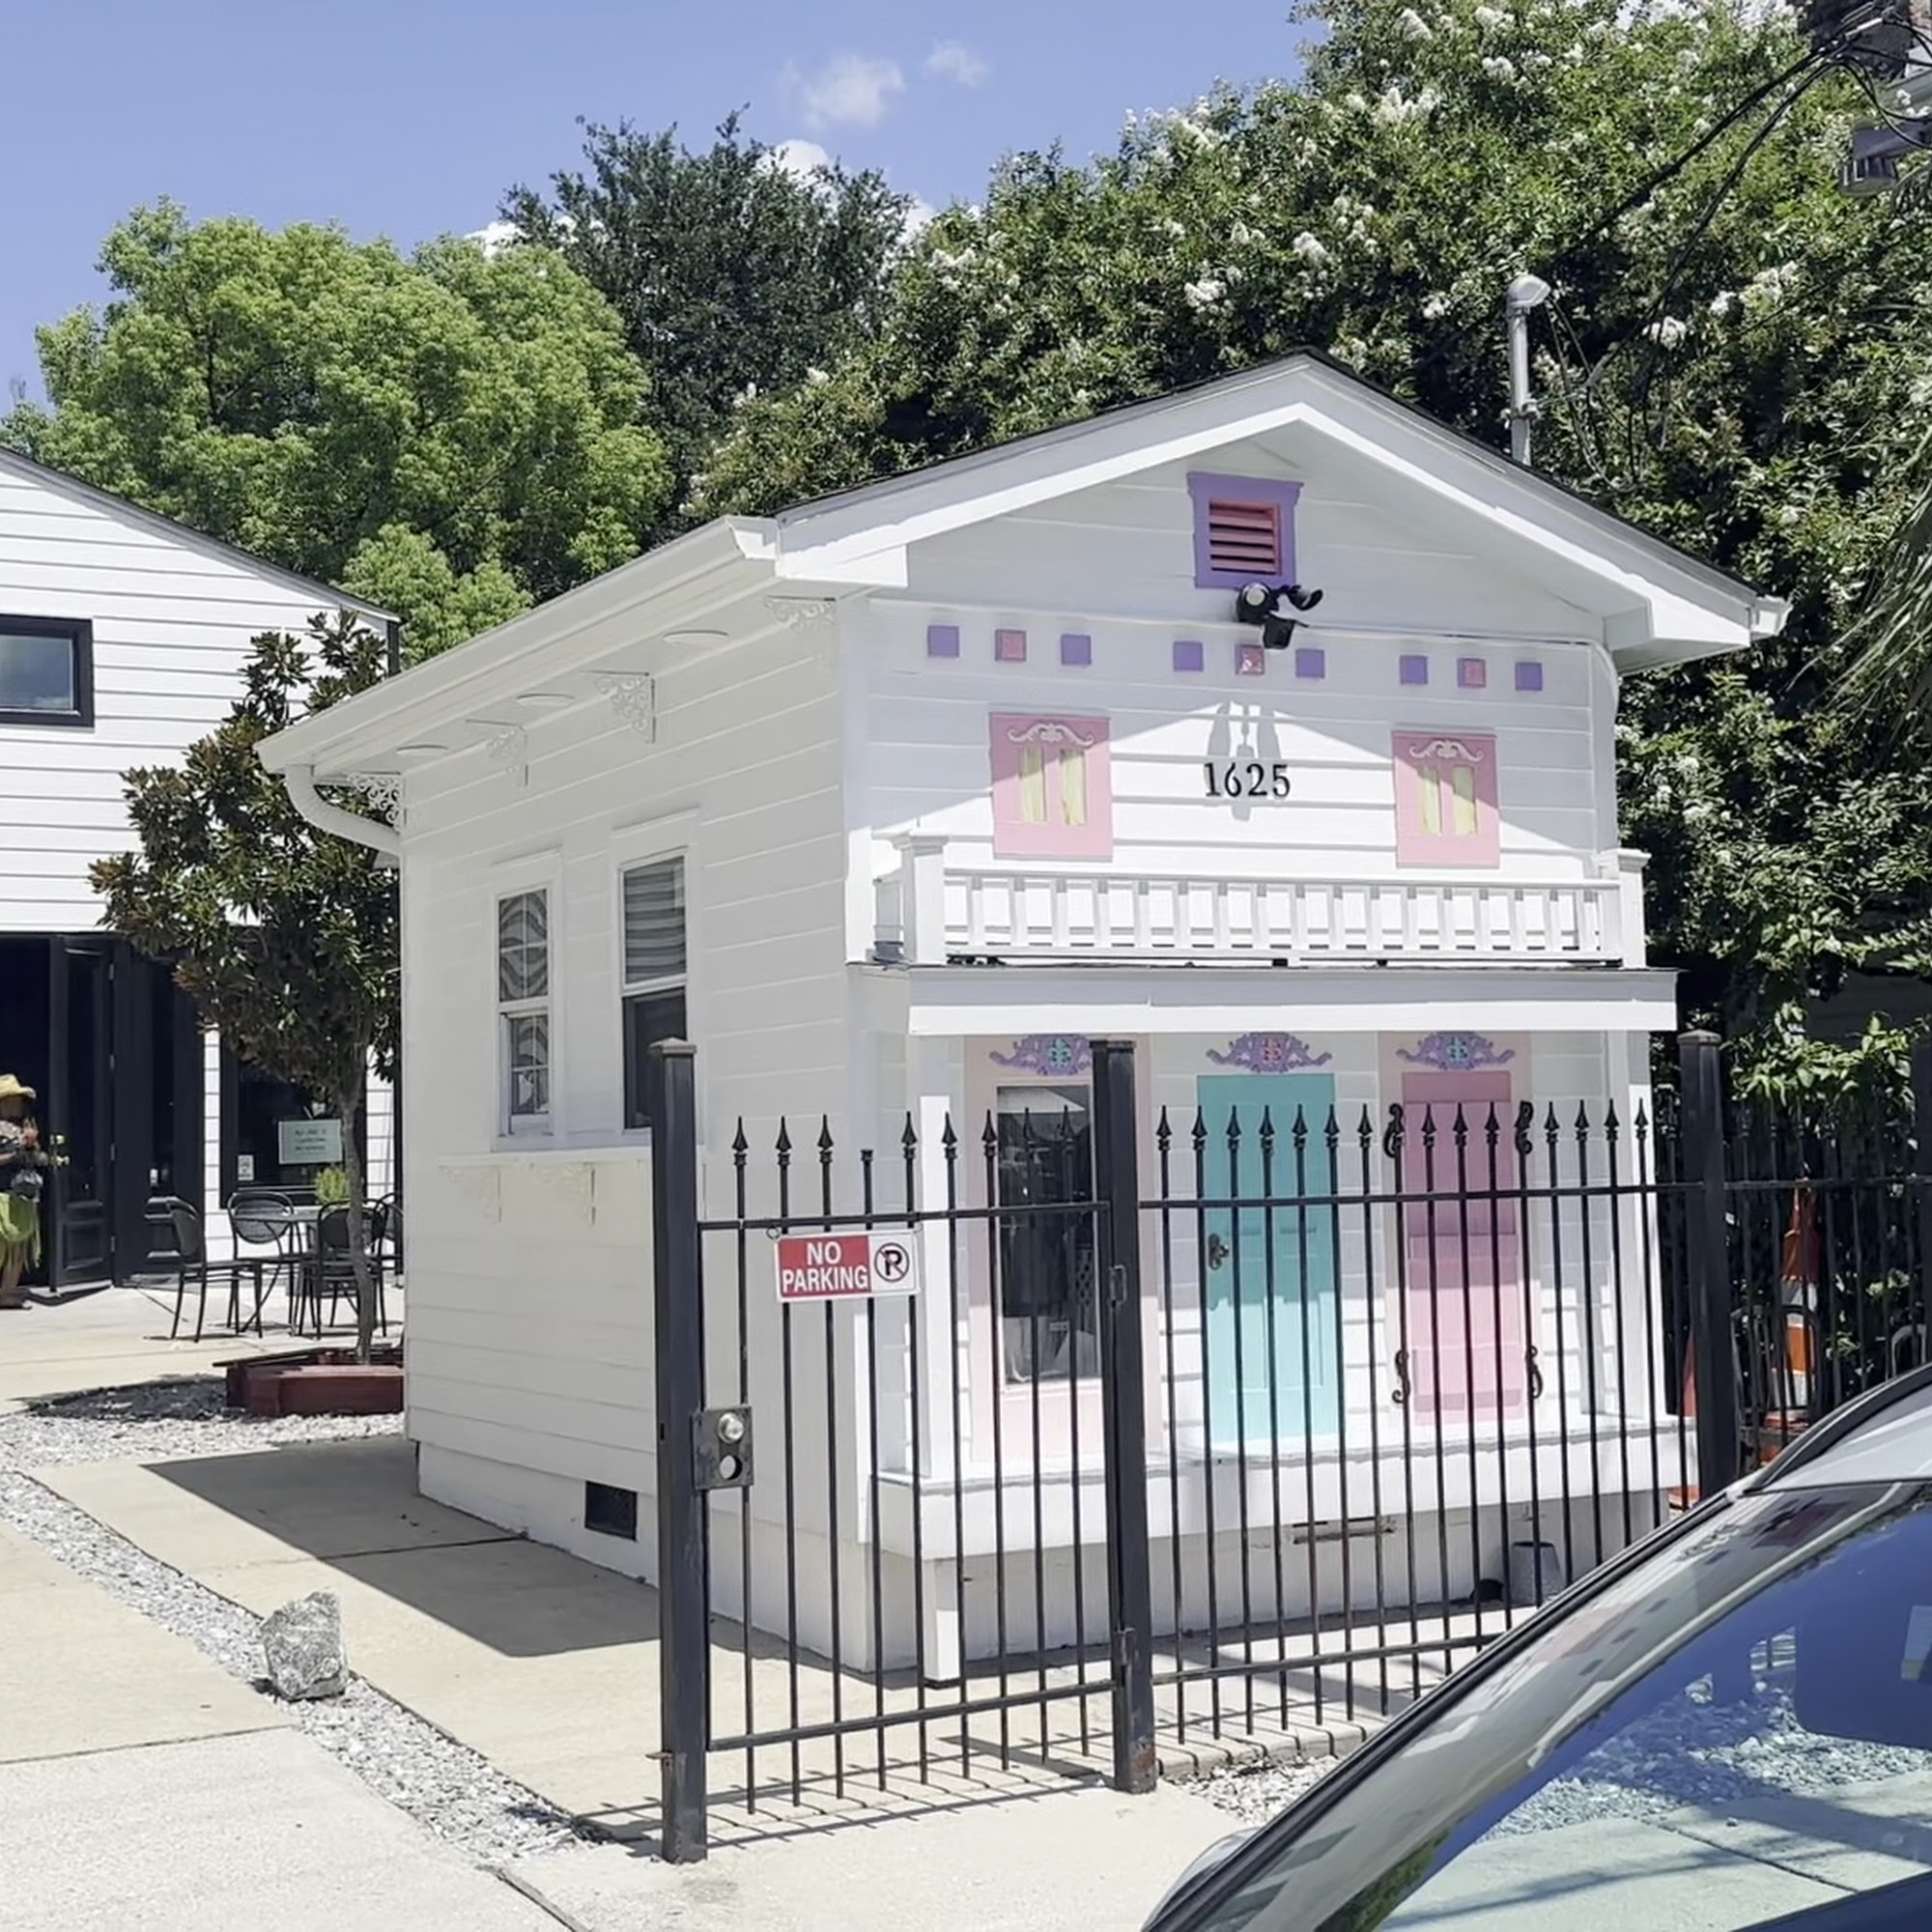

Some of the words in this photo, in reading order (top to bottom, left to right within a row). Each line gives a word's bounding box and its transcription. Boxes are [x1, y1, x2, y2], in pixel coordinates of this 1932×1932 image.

[1204, 761, 1291, 797] 1625
[807, 1241, 841, 1265] NO
[781, 1264, 868, 1293] PARKING
